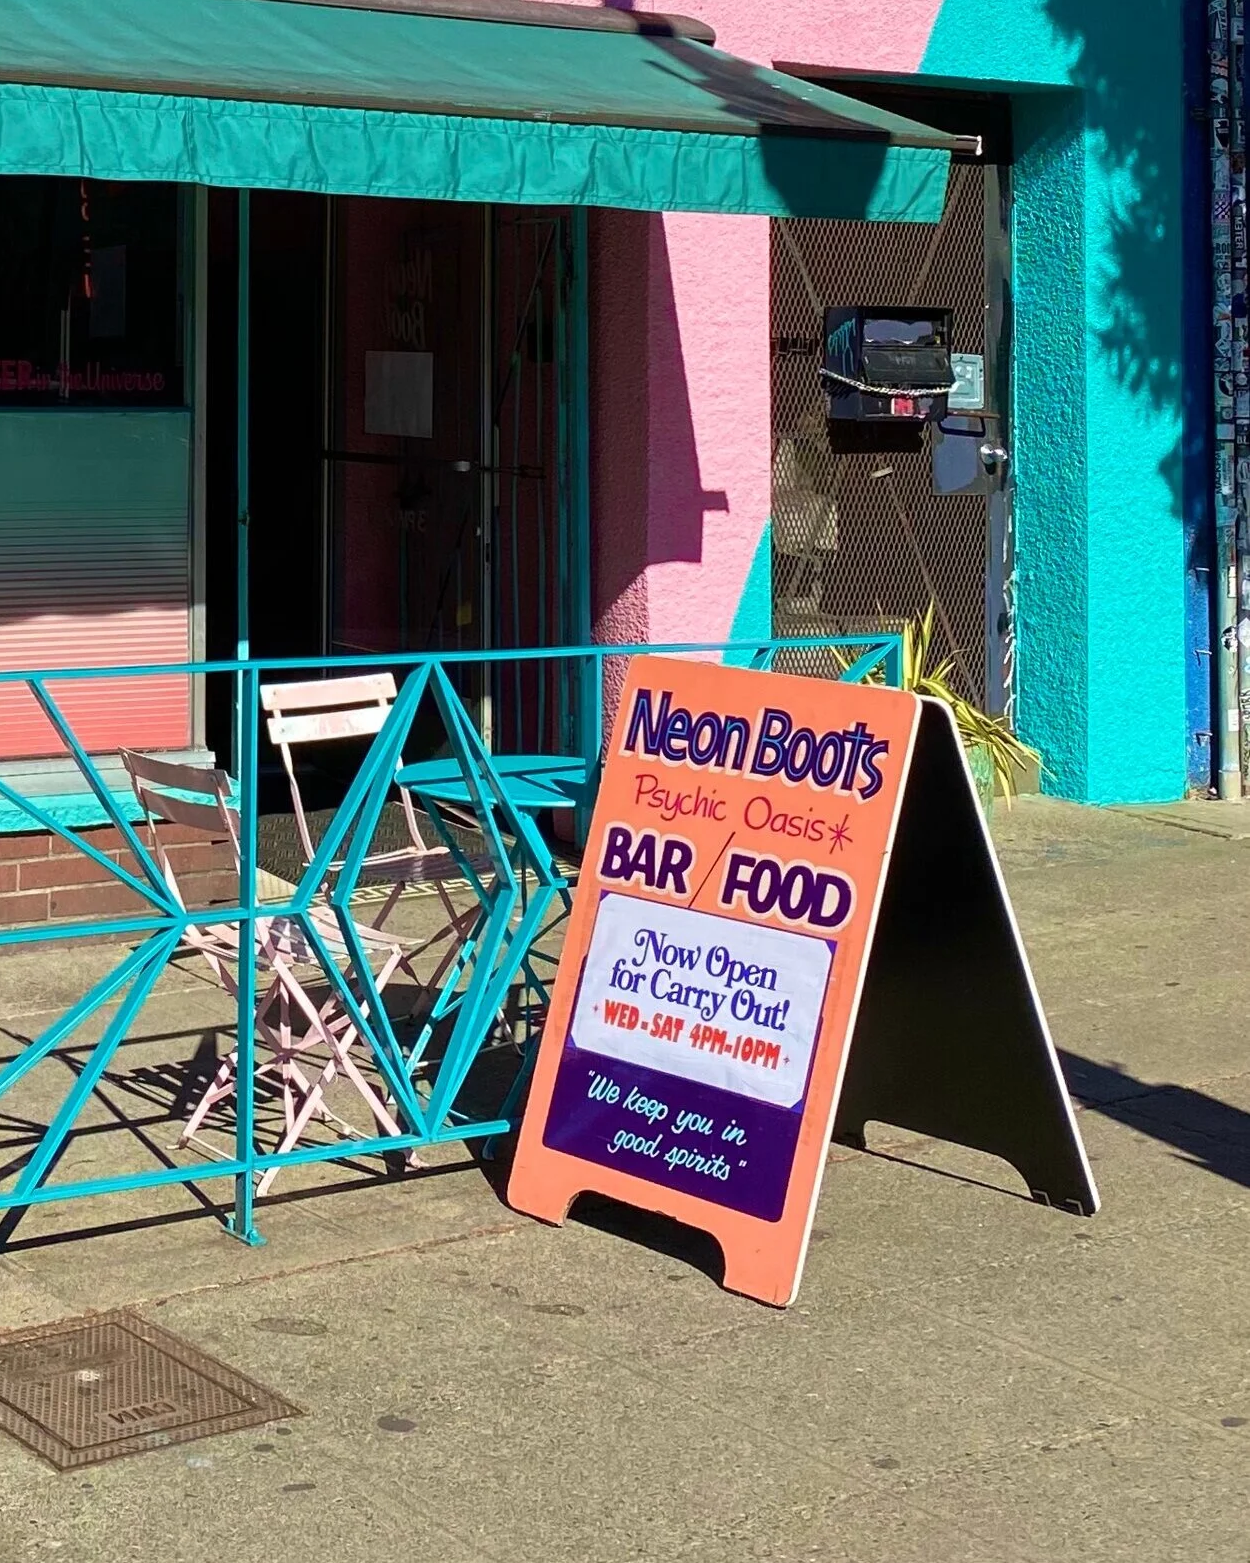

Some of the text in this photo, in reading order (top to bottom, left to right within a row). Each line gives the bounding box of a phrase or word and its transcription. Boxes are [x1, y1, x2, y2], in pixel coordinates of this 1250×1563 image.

[86, 360, 167, 392] Universe
[624, 688, 890, 800] Neon Boots
[634, 774, 728, 821] Psychic
[600, 826, 694, 895] BAR
[721, 851, 853, 928] FOOD
[633, 928, 778, 990] Now Open
[609, 958, 791, 1031] for Carry Out!
[607, 1128, 660, 1156] good
[623, 1086, 669, 1125] keep
[671, 1109, 714, 1136] you
[721, 1119, 748, 1146] in
